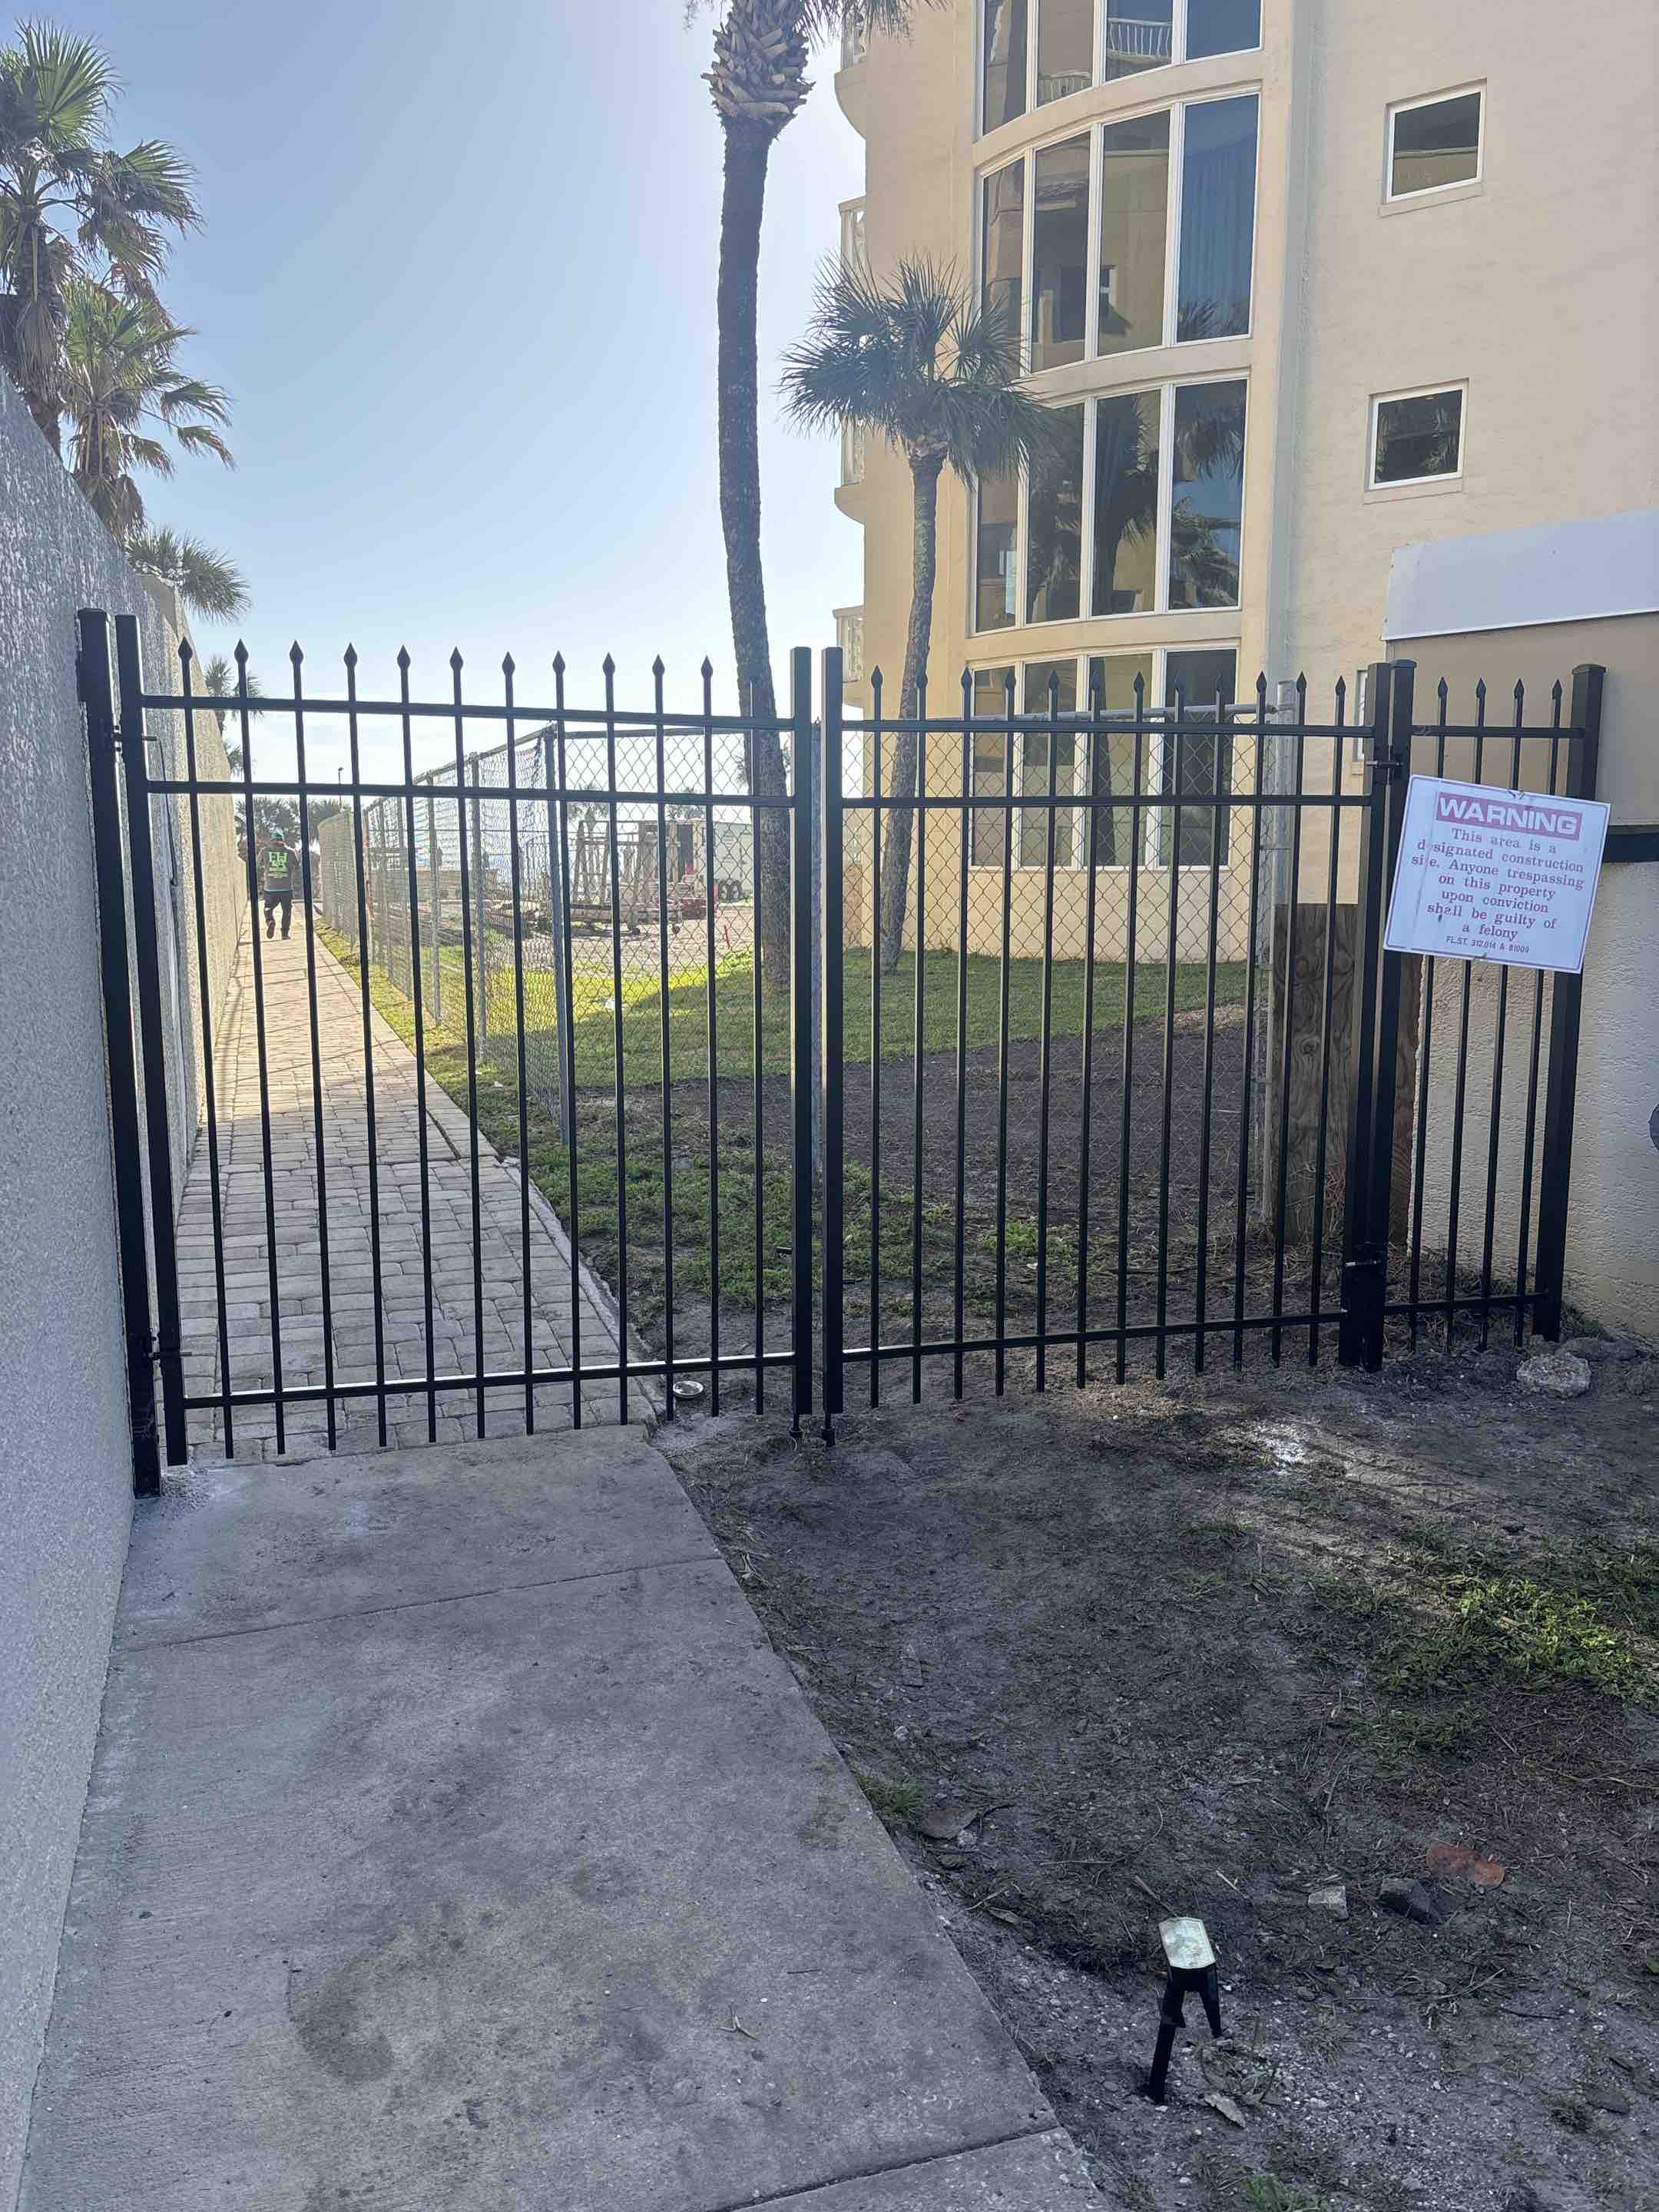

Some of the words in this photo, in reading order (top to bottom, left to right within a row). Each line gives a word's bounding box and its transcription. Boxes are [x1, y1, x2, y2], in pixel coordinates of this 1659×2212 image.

[1438, 796, 1578, 836] WARNING
[1451, 828, 1482, 843] This
[1491, 836, 1520, 849] area
[1530, 839, 1541, 852] is
[1549, 846, 1556, 854] a
[1417, 839, 1493, 859] dsignated
[1502, 853, 1584, 873] construction
[1412, 854, 1439, 867] sie.
[1449, 859, 1498, 876] Anyone
[1507, 869, 1584, 891] trespassing
[1439, 874, 1455, 886] on
[1464, 876, 1491, 890] this
[1498, 883, 1555, 901] property
[1442, 890, 1473, 904] upon
[1482, 896, 1548, 913] conviction
[1427, 903, 1462, 916] shall
[1472, 908, 1487, 920] be
[1494, 912, 1536, 929] guilty
[1544, 918, 1558, 929] of
[1462, 923, 1469, 933] a
[1479, 923, 1518, 942] felony
